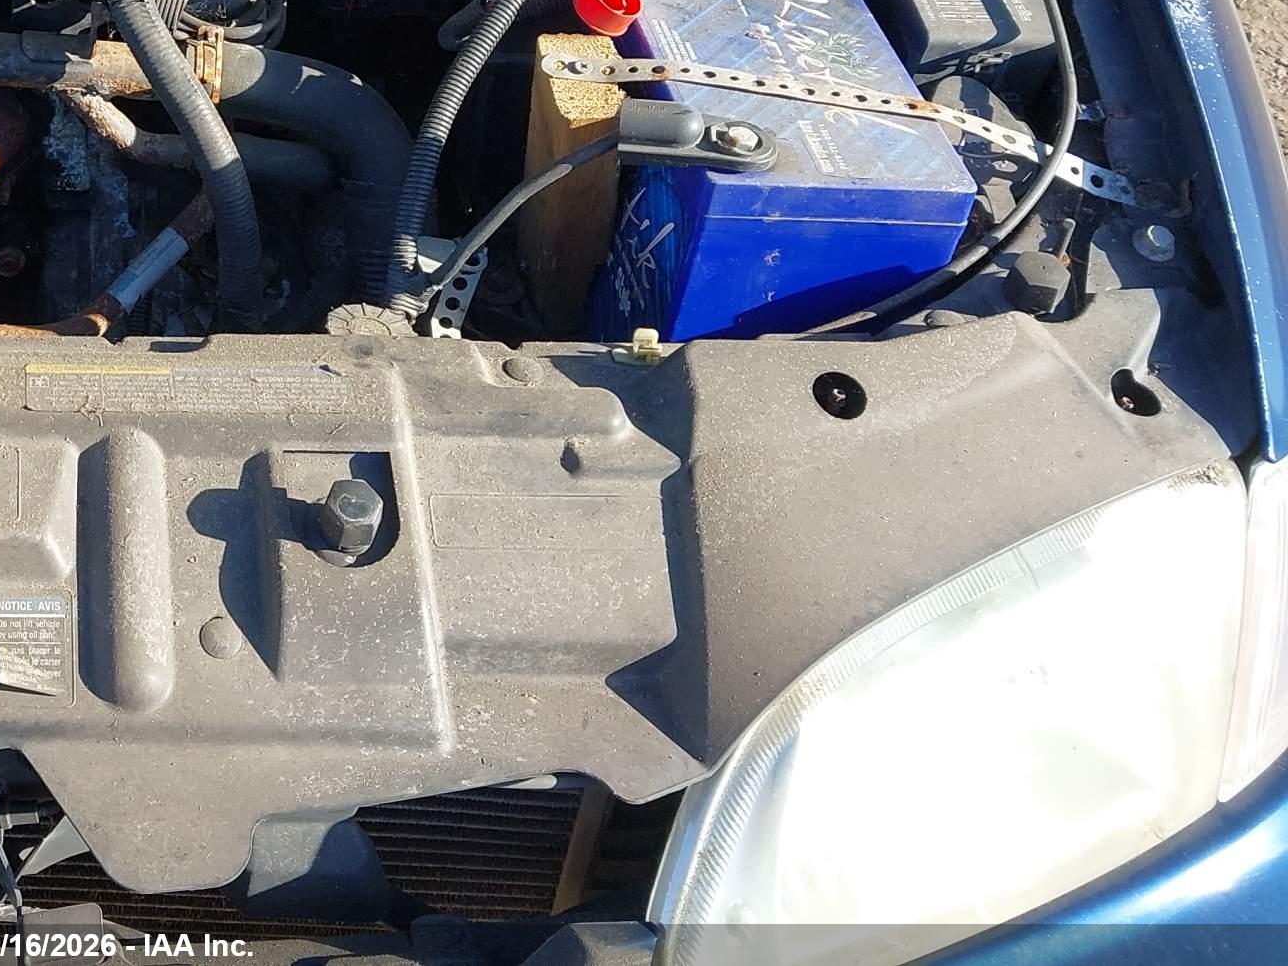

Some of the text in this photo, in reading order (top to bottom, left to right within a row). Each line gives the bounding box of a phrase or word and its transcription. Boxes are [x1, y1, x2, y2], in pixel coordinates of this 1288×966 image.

[38, 601, 61, 611] AVIS
[9, 620, 22, 629] not
[35, 620, 61, 628] vehicle
[7, 632, 28, 640] using
[29, 631, 38, 639] oil
[40, 658, 62, 666] carter
